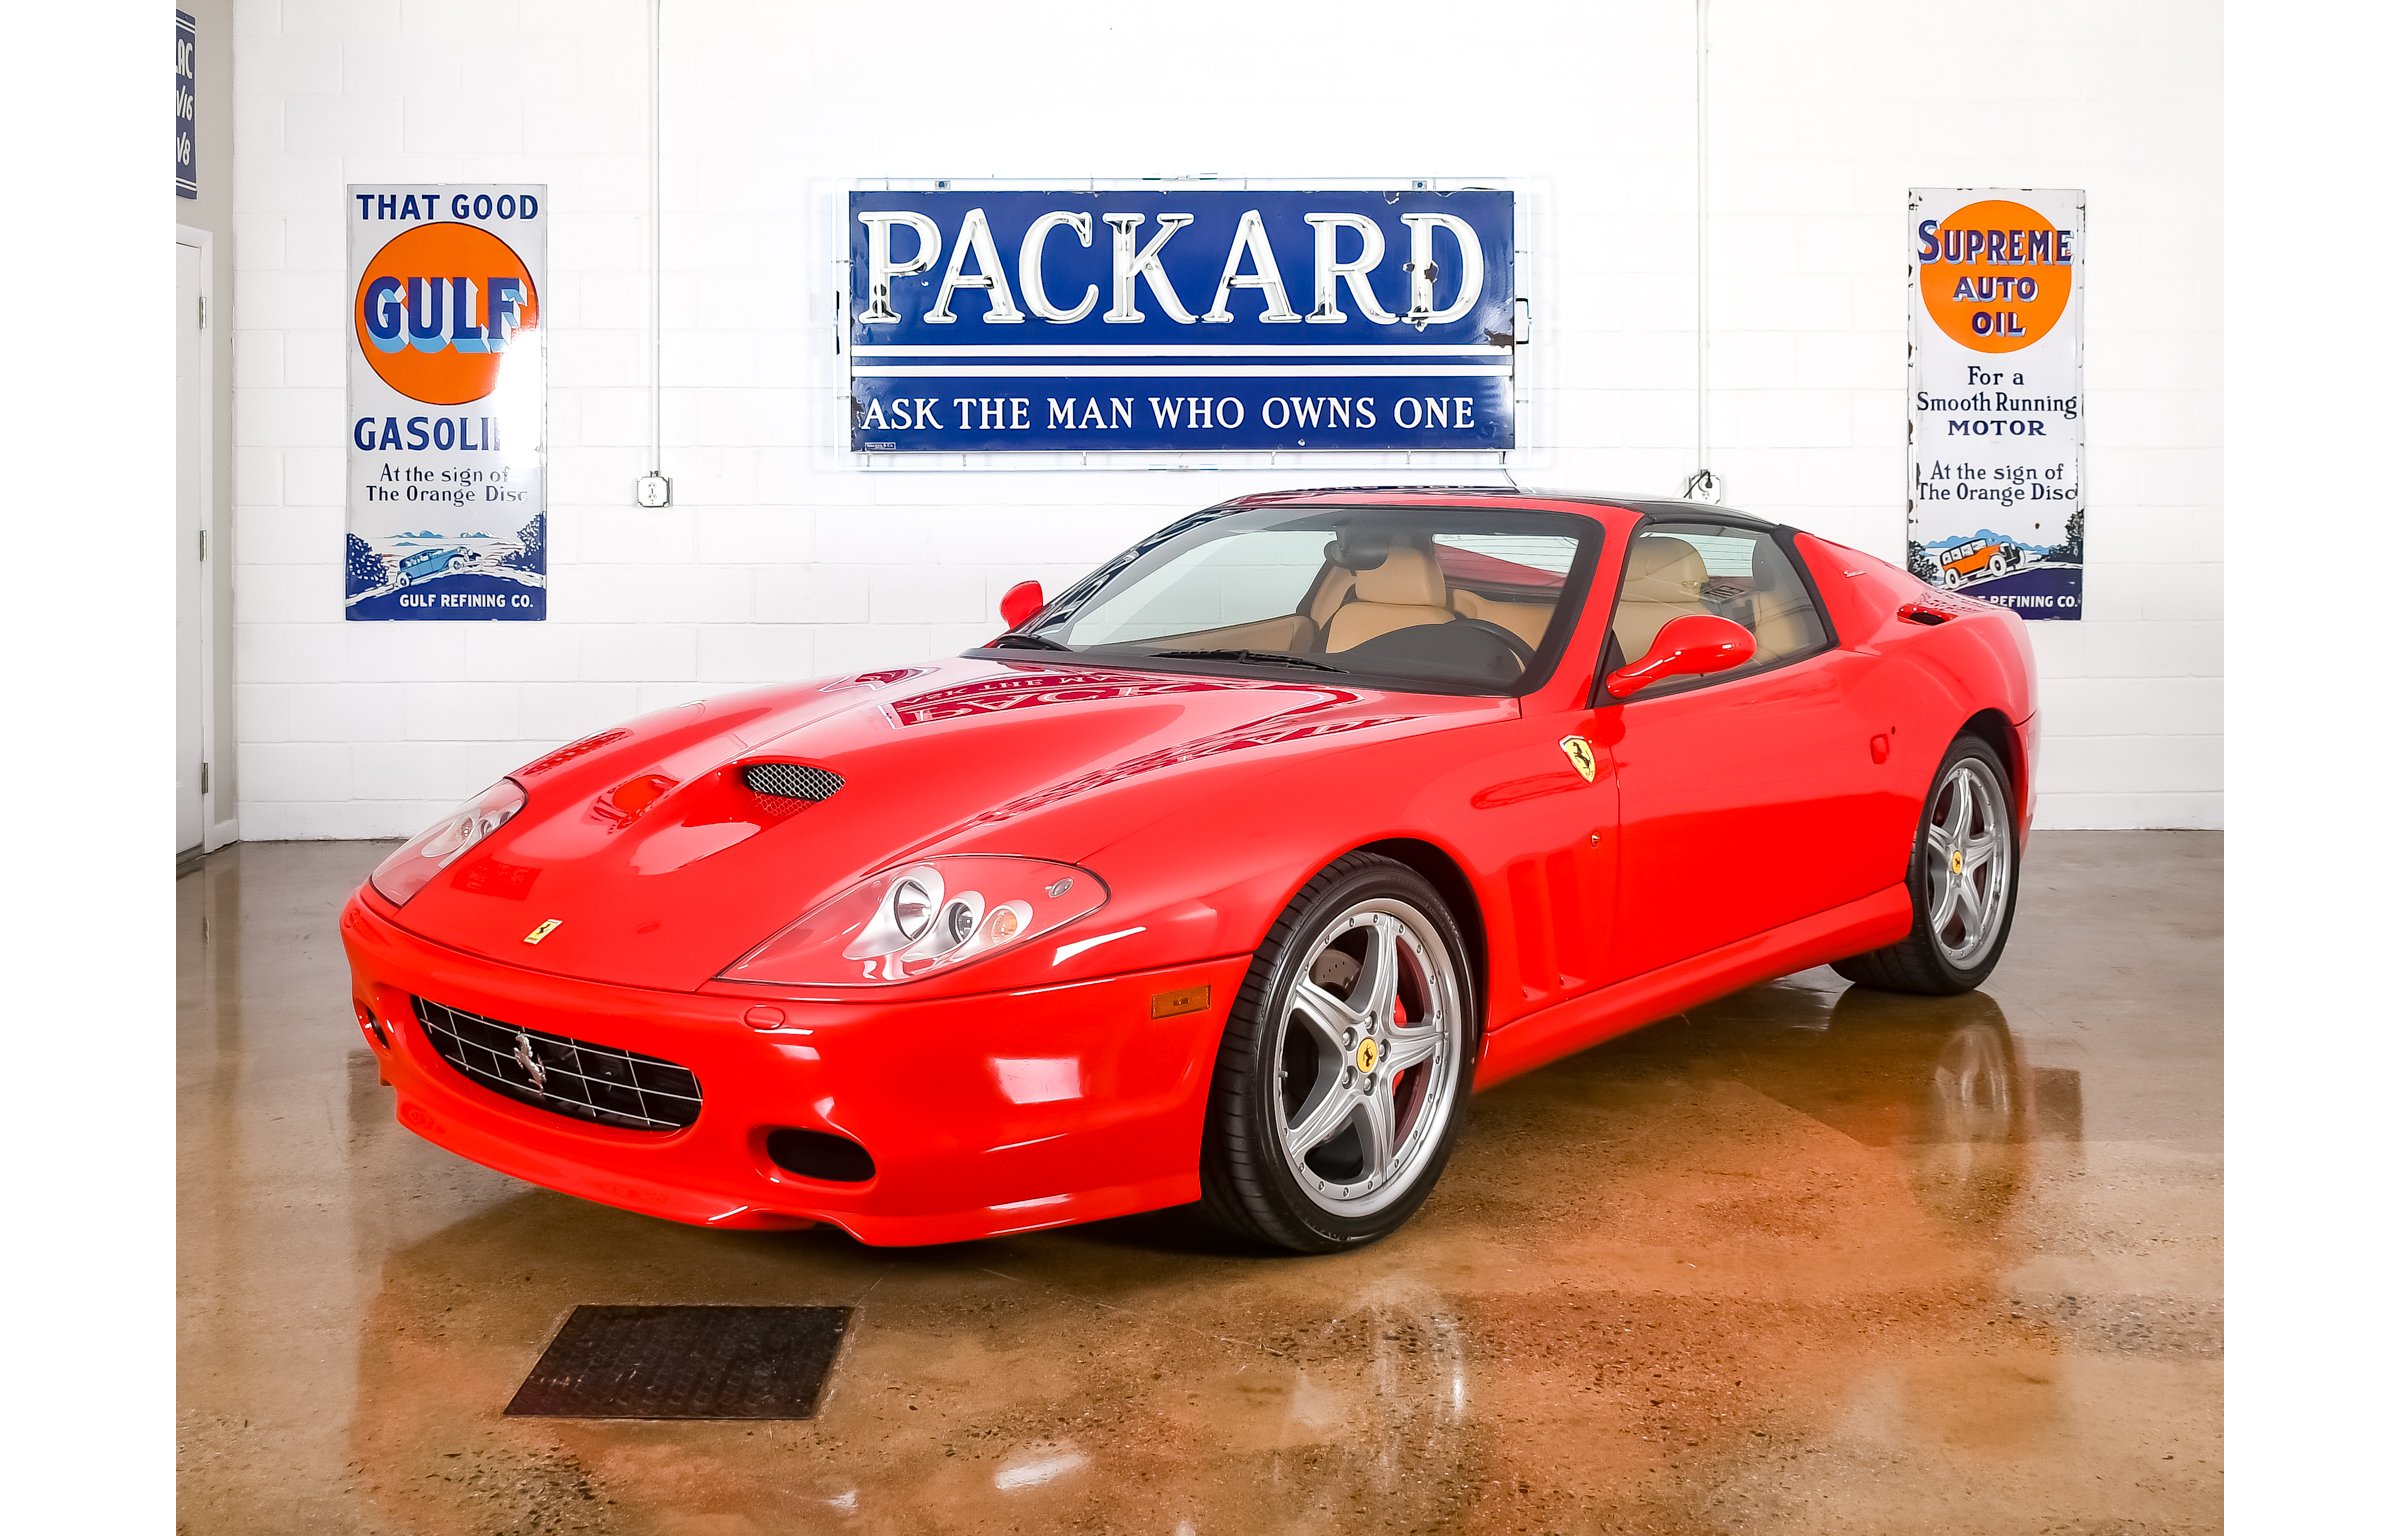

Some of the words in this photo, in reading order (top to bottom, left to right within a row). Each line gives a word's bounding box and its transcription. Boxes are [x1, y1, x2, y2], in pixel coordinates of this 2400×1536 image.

[176, 38, 193, 79] AC
[177, 131, 191, 166] V8
[356, 194, 441, 220] THAT
[451, 194, 539, 220] GOOD
[1917, 220, 2075, 266] SUPREME
[857, 207, 1485, 325] PACKARD
[1953, 276, 2038, 303] AUTO
[364, 276, 528, 354] GULF
[1972, 311, 2026, 337] OIL
[1967, 366, 2004, 386] For
[2012, 372, 2025, 386] a
[860, 397, 944, 431] ASK
[953, 397, 1031, 431] THE
[1046, 397, 1135, 431] MAN
[1148, 396, 1245, 430] WHO
[1262, 396, 1377, 429] OWNS
[1393, 396, 1476, 429] ONE
[1917, 391, 1992, 413] Smooth
[1995, 391, 2078, 420] Running
[354, 416, 501, 451] GASOLI
[1947, 420, 2047, 436] MOTOR
[380, 463, 400, 482] At
[405, 466, 435, 482] the
[441, 467, 483, 487] sign
[490, 466, 511, 482] of
[1930, 460, 1951, 480] At
[1956, 462, 1987, 480] the
[1993, 464, 2038, 485] sign
[2045, 463, 2064, 480] of
[366, 485, 400, 502] The
[407, 485, 476, 508] Orange
[485, 485, 528, 503] Disc
[1919, 483, 1951, 501] The
[1956, 483, 2025, 507] Orange
[2030, 483, 2077, 501] Disc
[400, 594, 435, 608] GULF
[441, 594, 506, 608] REFINING
[511, 594, 534, 608] CO.
[2057, 596, 2078, 608] CO.
